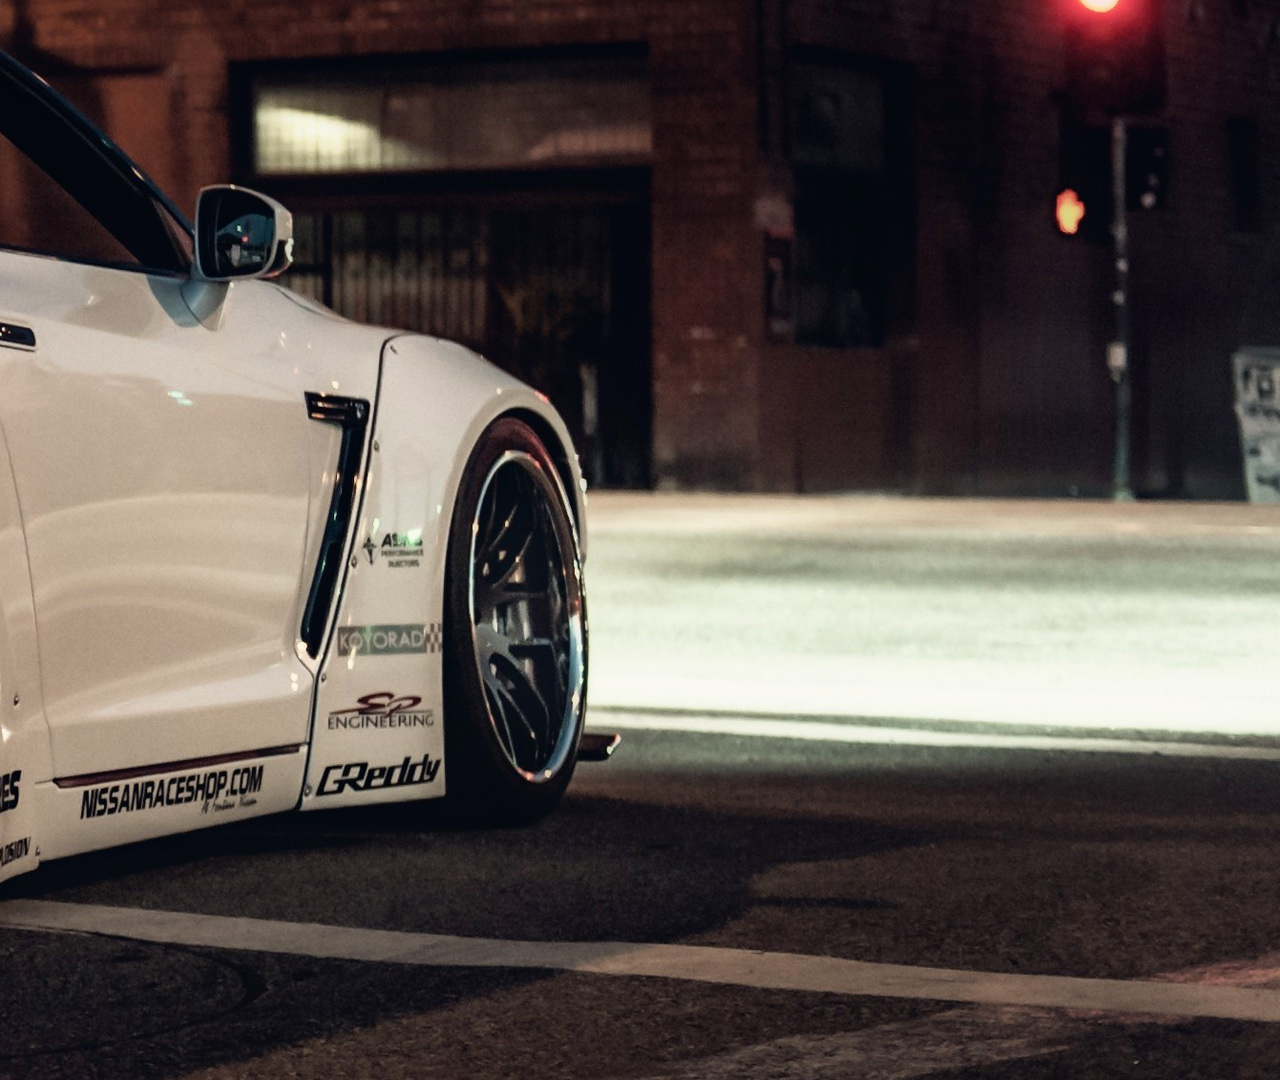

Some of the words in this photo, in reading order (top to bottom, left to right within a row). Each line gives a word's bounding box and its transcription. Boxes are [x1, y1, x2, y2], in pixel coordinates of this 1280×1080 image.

[341, 630, 425, 650] KOYORAD
[328, 714, 434, 730] ENGINEERING
[316, 753, 441, 797] GReddy
[80, 766, 264, 820] NISSANRACESHOP.COM
